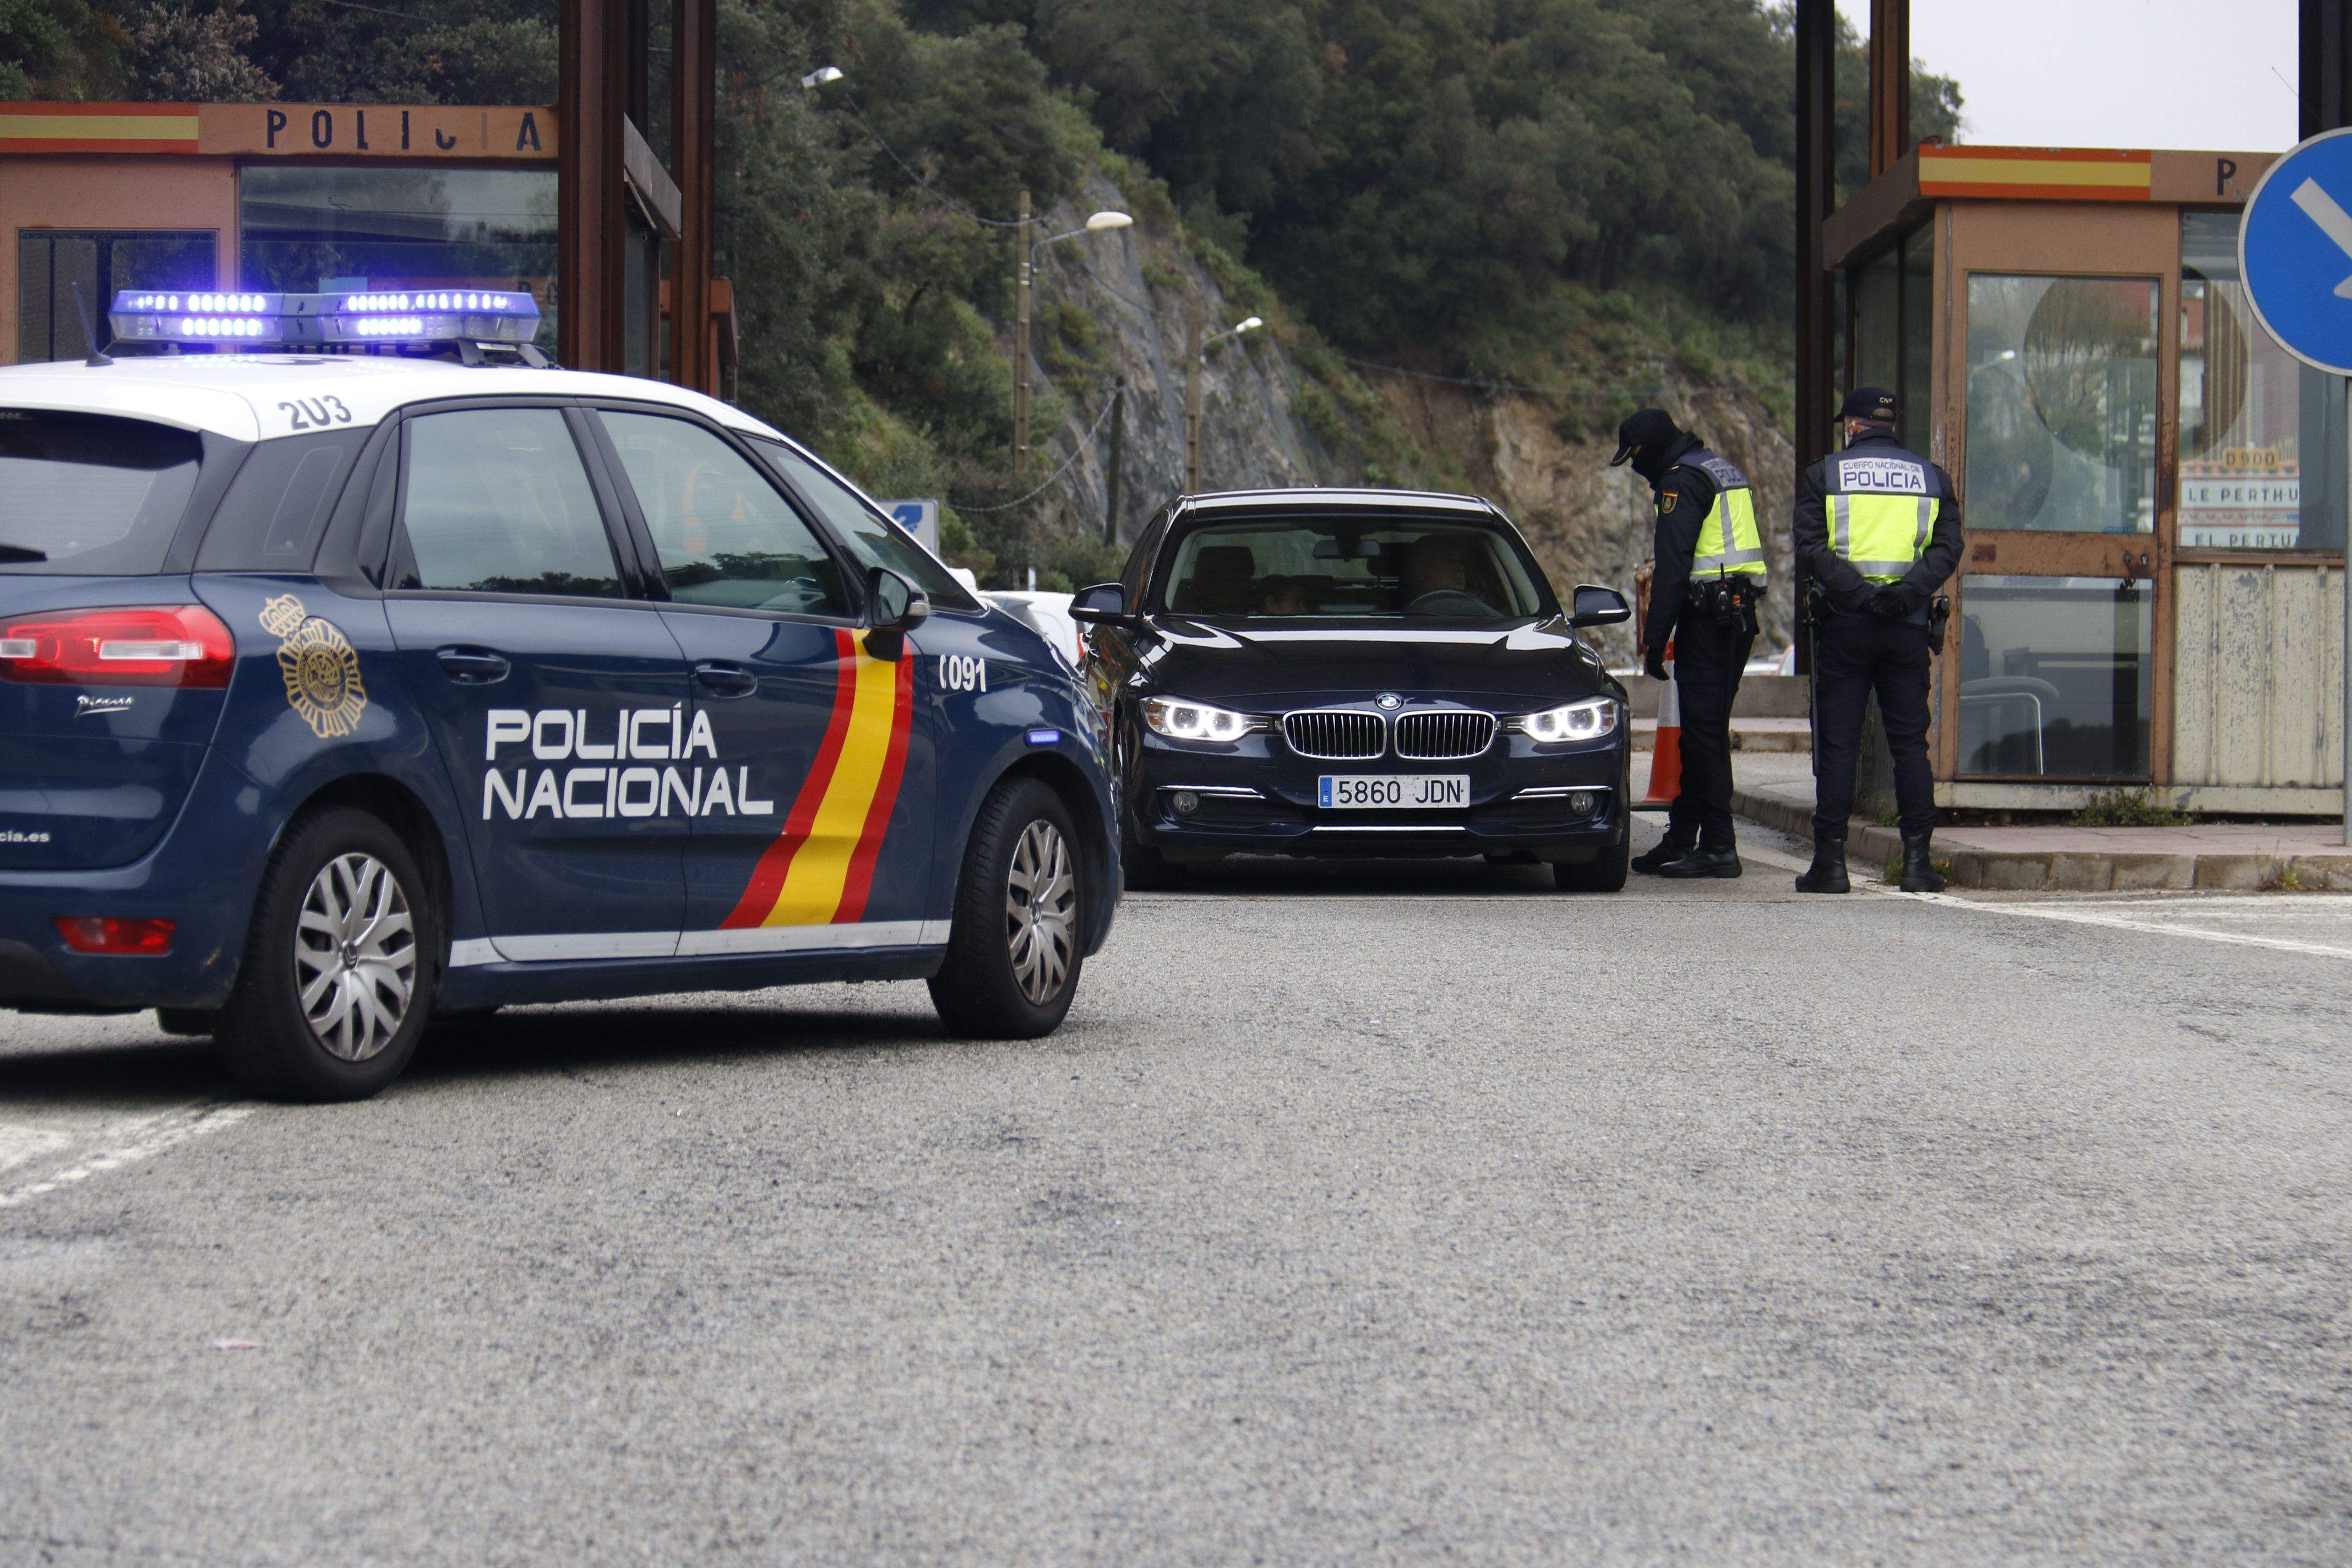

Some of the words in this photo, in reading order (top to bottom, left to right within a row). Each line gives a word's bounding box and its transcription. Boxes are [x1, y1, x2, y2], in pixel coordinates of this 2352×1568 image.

[277, 395, 352, 431] 2U3
[1843, 461, 1874, 470] CUERPO
[1875, 461, 1909, 471] NACIONAL
[1910, 465, 1920, 473] DE
[1844, 471, 1921, 489] POLICIA
[2188, 487, 2209, 502] LE
[948, 655, 987, 693] 091
[486, 701, 717, 760] POLICÍA
[482, 766, 774, 820] NACIONAL
[1338, 780, 1401, 804] 5860
[1415, 780, 1461, 804] JDN
